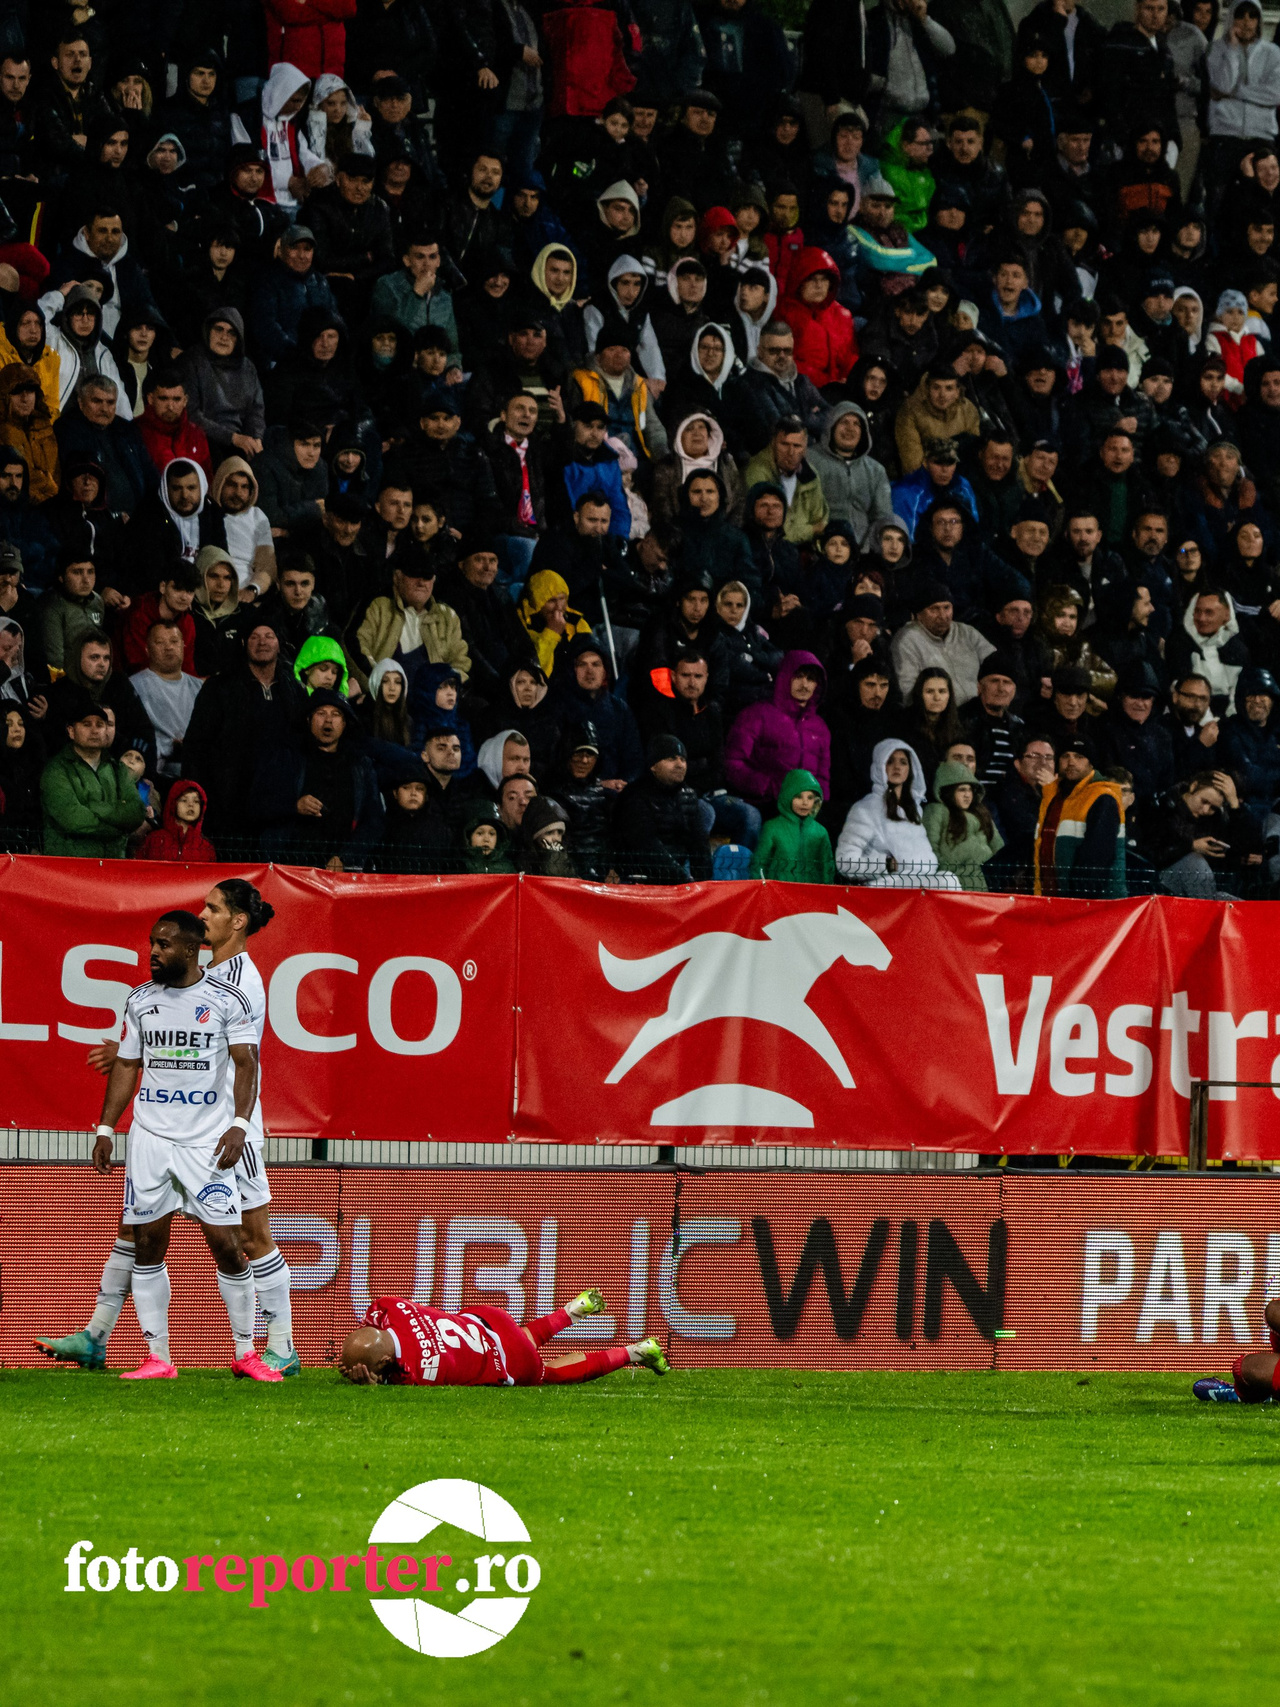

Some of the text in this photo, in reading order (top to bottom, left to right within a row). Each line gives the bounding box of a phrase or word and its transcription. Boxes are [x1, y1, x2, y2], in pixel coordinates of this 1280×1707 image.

[144, 1030, 215, 1049] UNIBET
[178, 1062, 196, 1070] SPRE
[196, 1062, 207, 1070] 0%
[139, 1087, 218, 1105] ELSACO
[134, 1208, 154, 1217] estra
[396, 1302, 433, 1368] Regata.ro
[435, 1317, 485, 1355] 2
